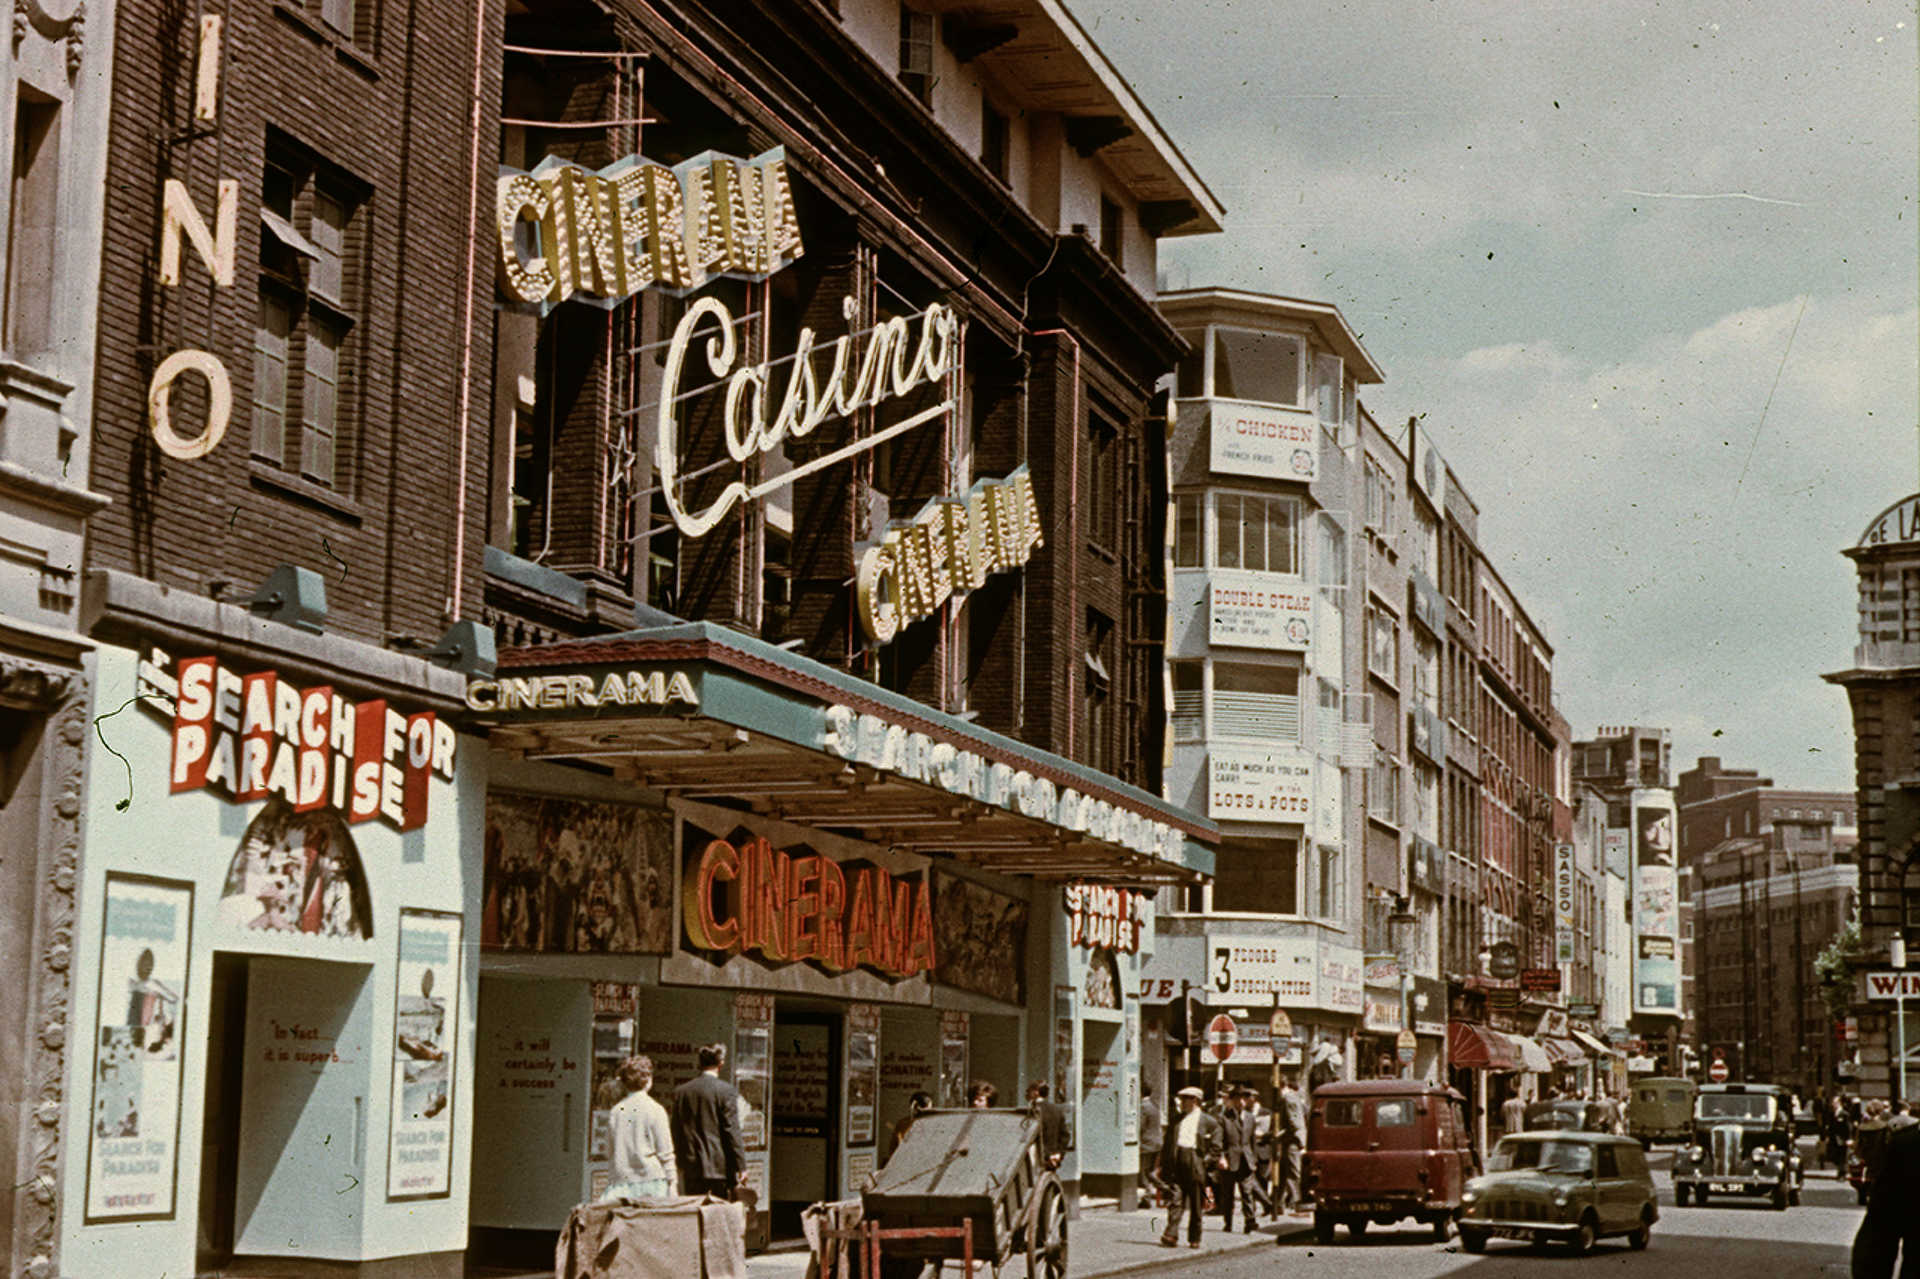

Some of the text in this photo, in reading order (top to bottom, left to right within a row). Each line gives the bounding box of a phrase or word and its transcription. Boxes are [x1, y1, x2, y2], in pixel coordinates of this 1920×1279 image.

[499, 159, 804, 303] CINERAMA
[658, 296, 954, 538] Casino
[1236, 419, 1312, 442] CHICKEN
[179, 663, 356, 757] SEARCH
[383, 708, 455, 778] FOR
[466, 671, 700, 711] CINERAMA
[173, 725, 405, 827] PARADISE
[825, 704, 986, 802] SEARCH
[990, 763, 1057, 824] FOR
[1270, 796, 1309, 812] POTS
[697, 837, 936, 976] CINERAMA
[1558, 846, 1571, 912] SASSO
[1215, 947, 1231, 993] 3
